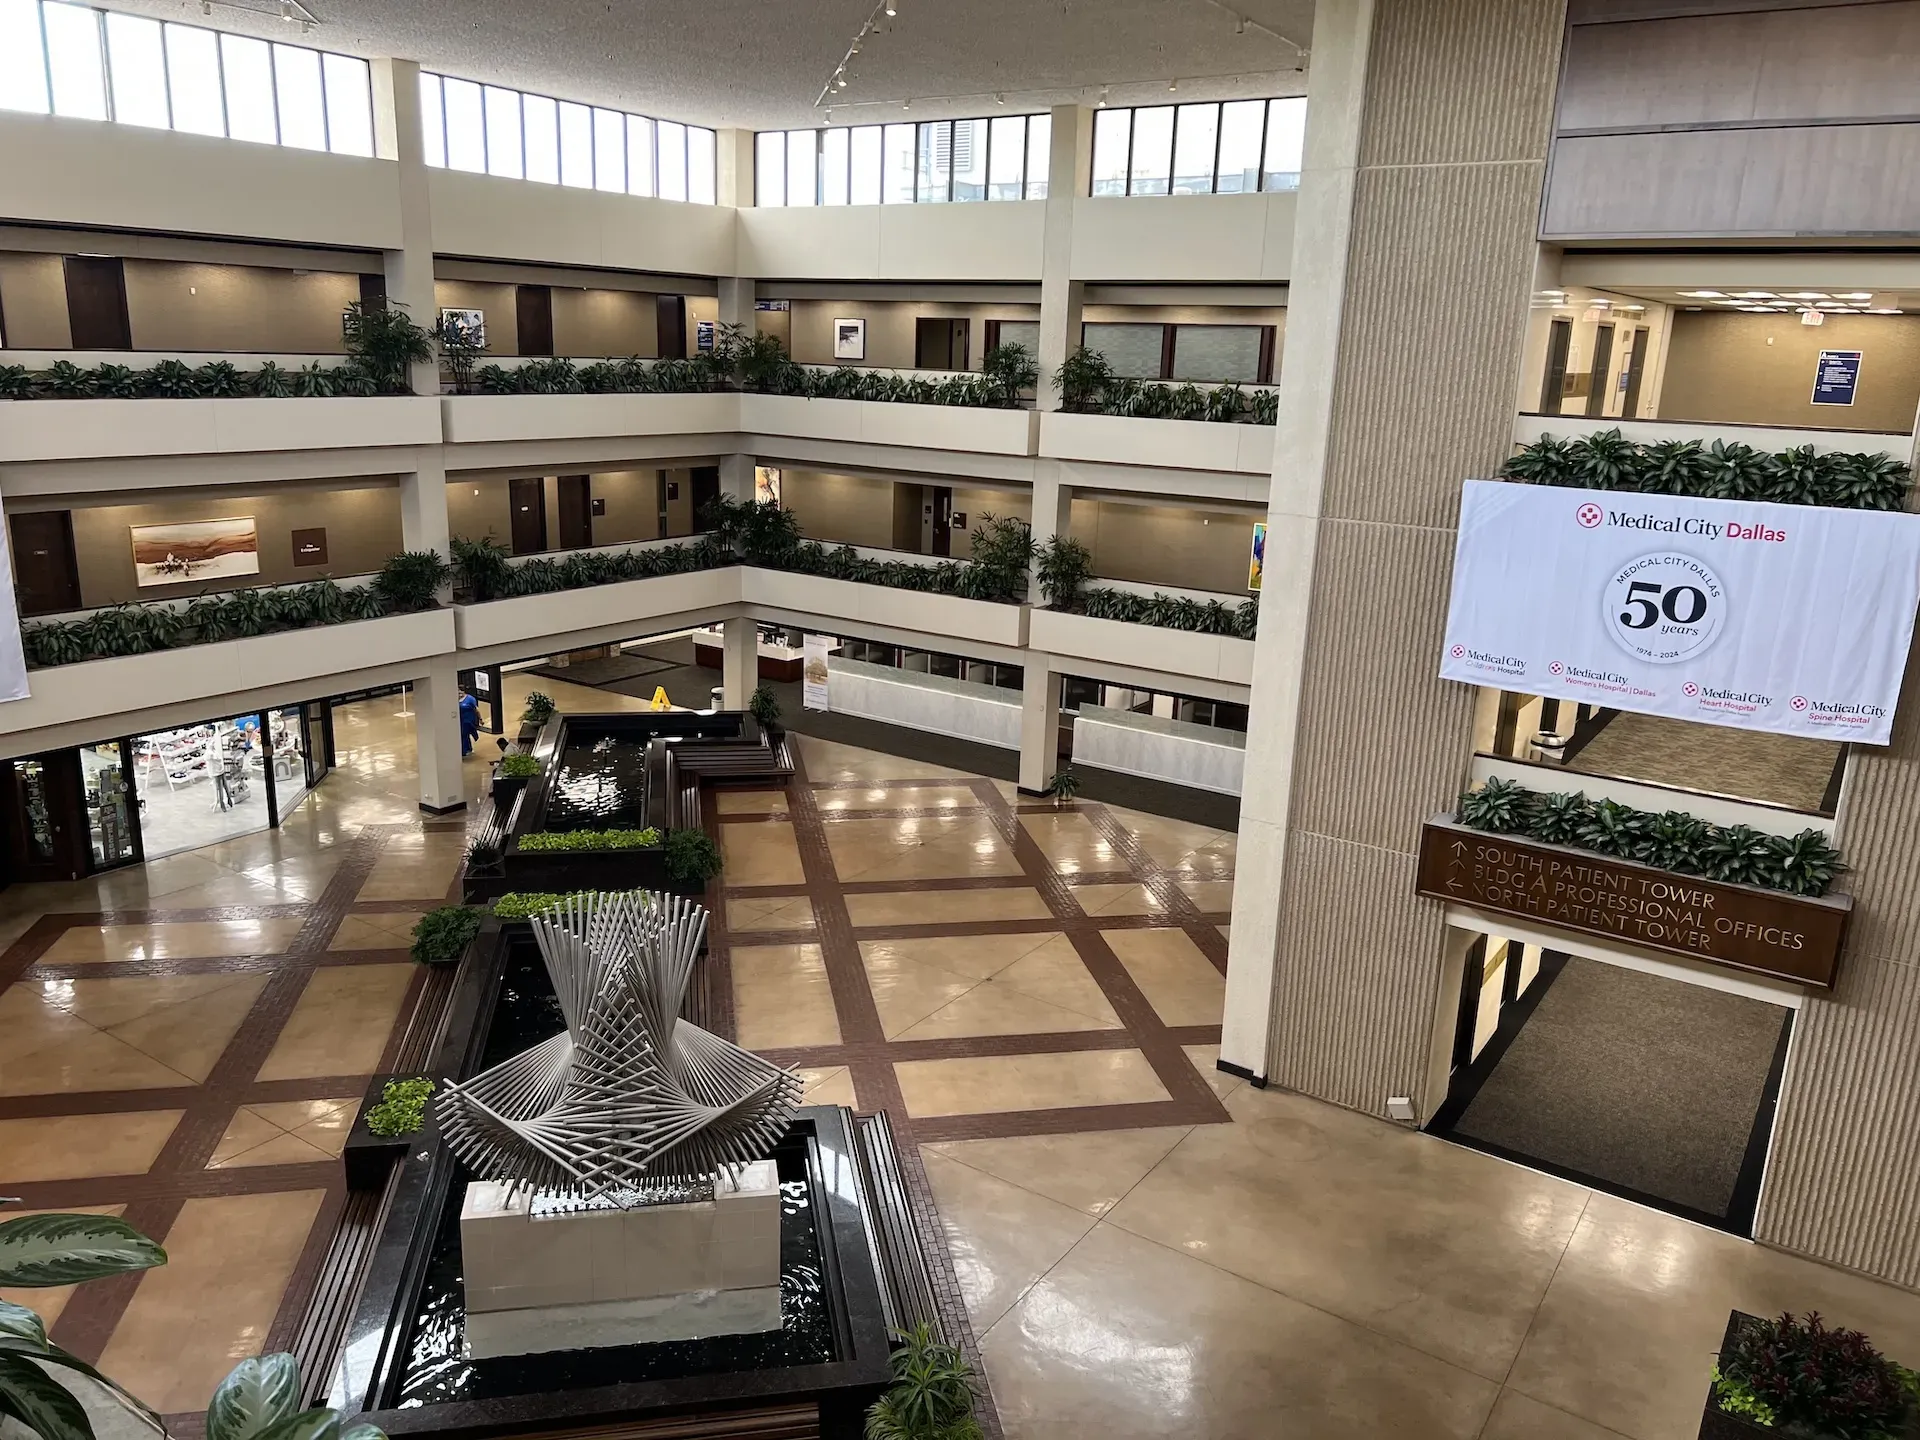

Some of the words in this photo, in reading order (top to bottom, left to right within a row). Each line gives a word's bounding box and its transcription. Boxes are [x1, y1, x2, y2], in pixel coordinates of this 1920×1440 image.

[1607, 511, 1680, 533] Medical
[1684, 518, 1723, 540] City
[1726, 522, 1786, 542] Dallas
[1616, 558, 1661, 584] MEDICAL
[1664, 556, 1690, 568] CITY
[1689, 563, 1720, 598] DALLAS
[1620, 581, 1707, 629] 50
[1660, 624, 1699, 637] years
[1467, 649, 1505, 665] Medical
[1506, 656, 1527, 670] City
[1636, 647, 1652, 656] 1974
[1497, 666, 1526, 676] Hospital
[1566, 666, 1606, 681] Medical
[1607, 673, 1629, 686] City
[1565, 676, 1597, 688] Women's
[1598, 682, 1628, 693] Hospital
[1633, 688, 1656, 697] Dallas
[1699, 699, 1722, 707] Heart
[1723, 701, 1757, 712] Hospital
[1701, 687, 1747, 702] Medical
[1748, 693, 1773, 707] City
[1808, 712, 1833, 722] Spine
[1834, 714, 1870, 724] Hospital
[1810, 701, 1860, 714] Medical
[1861, 704, 1887, 719] City
[1474, 845, 1543, 873] SOUTH
[1550, 861, 1632, 891] PATIENT
[1639, 879, 1715, 911] TOWER
[1471, 882, 1541, 911] NORTH
[1546, 899, 1629, 931] PATIENT
[1635, 918, 1711, 950] TOWER
[1475, 864, 1526, 889] BLDG
[1530, 874, 1547, 893] A
[1554, 882, 1706, 929] PROFESSIONAL
[1714, 917, 1805, 950] OFFICES
